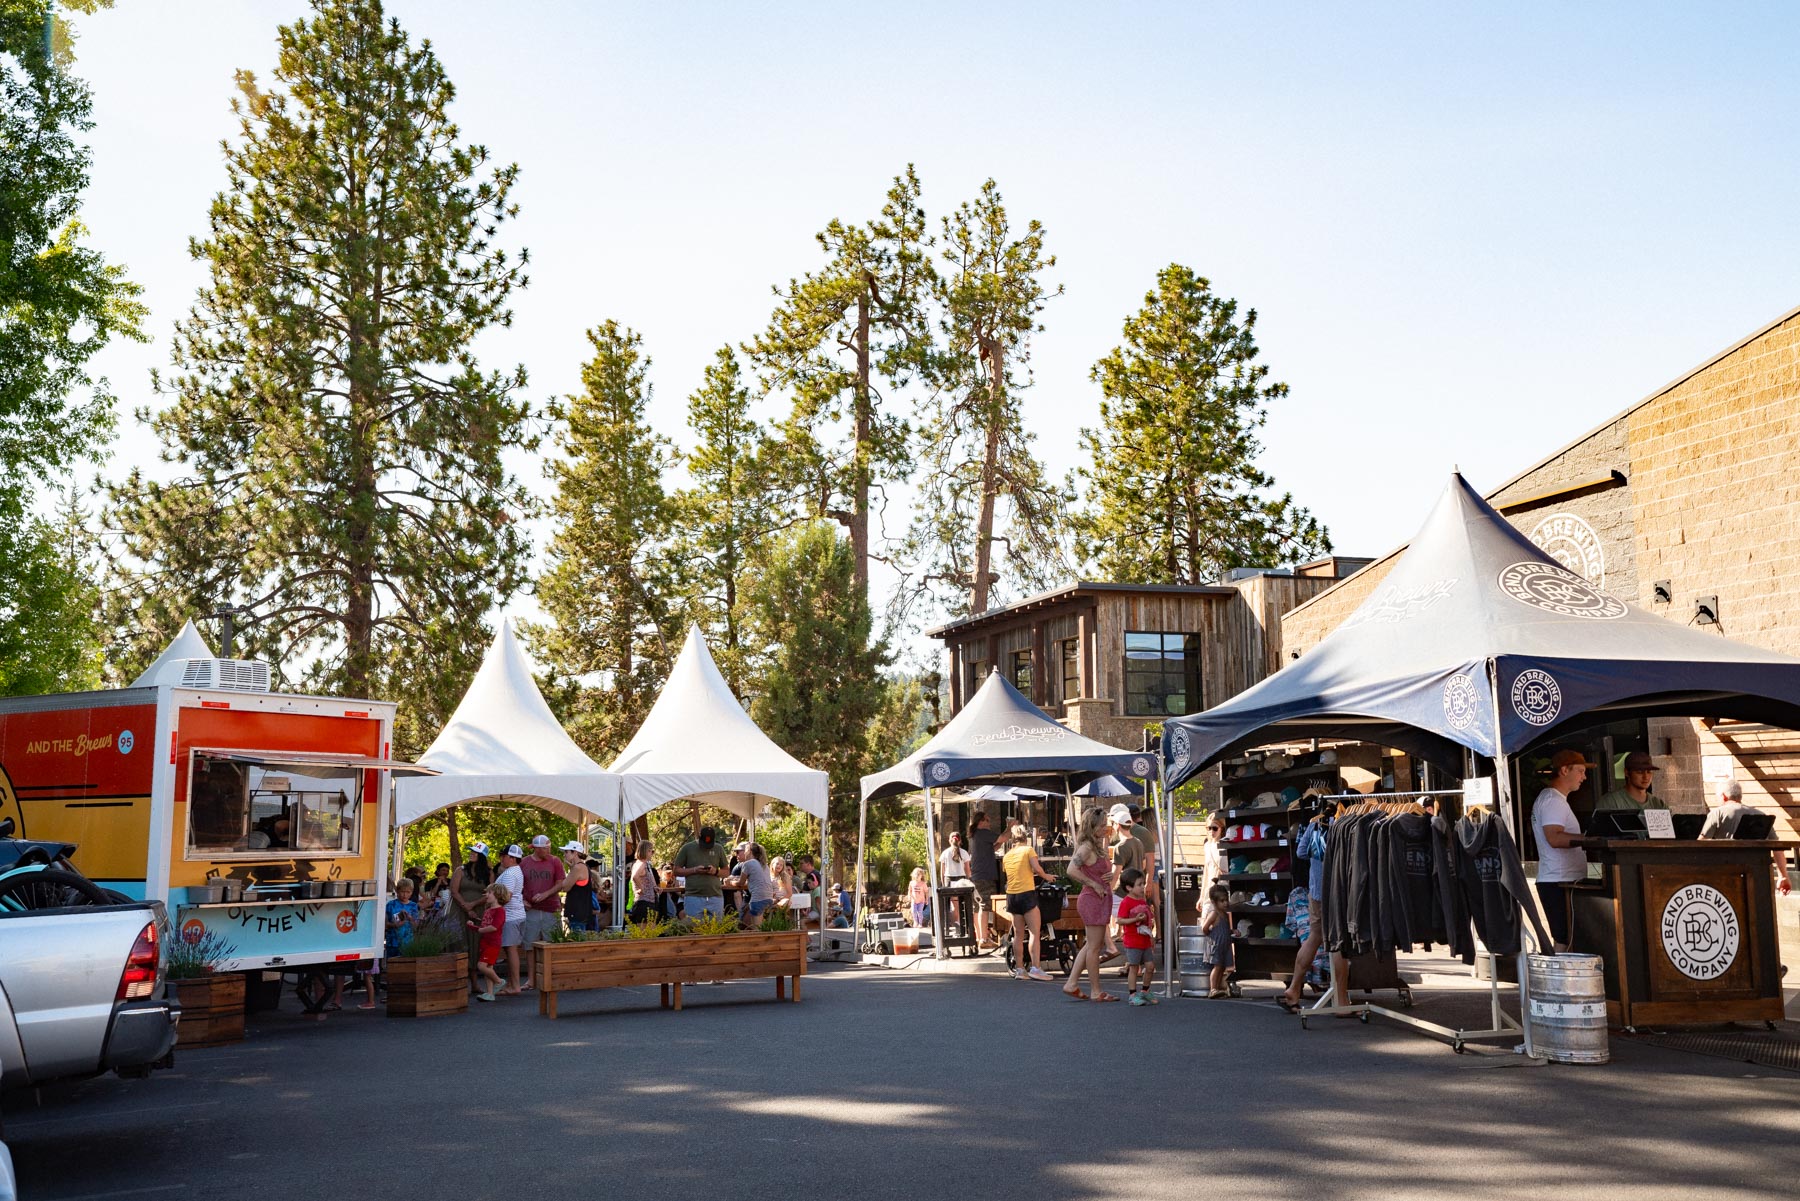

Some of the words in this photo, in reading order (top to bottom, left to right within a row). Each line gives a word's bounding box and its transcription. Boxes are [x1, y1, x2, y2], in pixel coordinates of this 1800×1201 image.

[1543, 519, 1601, 577] BREWING
[1504, 572, 1534, 600] BEND
[1539, 598, 1622, 617] COMPANY
[1513, 676, 1527, 702] BEND
[1526, 671, 1559, 702] BREWING
[1518, 705, 1556, 723] COMPANY
[26, 741, 51, 754] AND
[52, 739, 73, 752] THE
[74, 733, 113, 756] Brews
[120, 737, 132, 748] 95
[971, 728, 1010, 746] Bend
[1007, 725, 1068, 741] Brewing
[256, 914, 293, 933] THE
[338, 916, 353, 928] 95
[1664, 896, 1684, 939] BEND
[1685, 887, 1737, 937] BREWING
[1671, 946, 1733, 977] COMPANY
